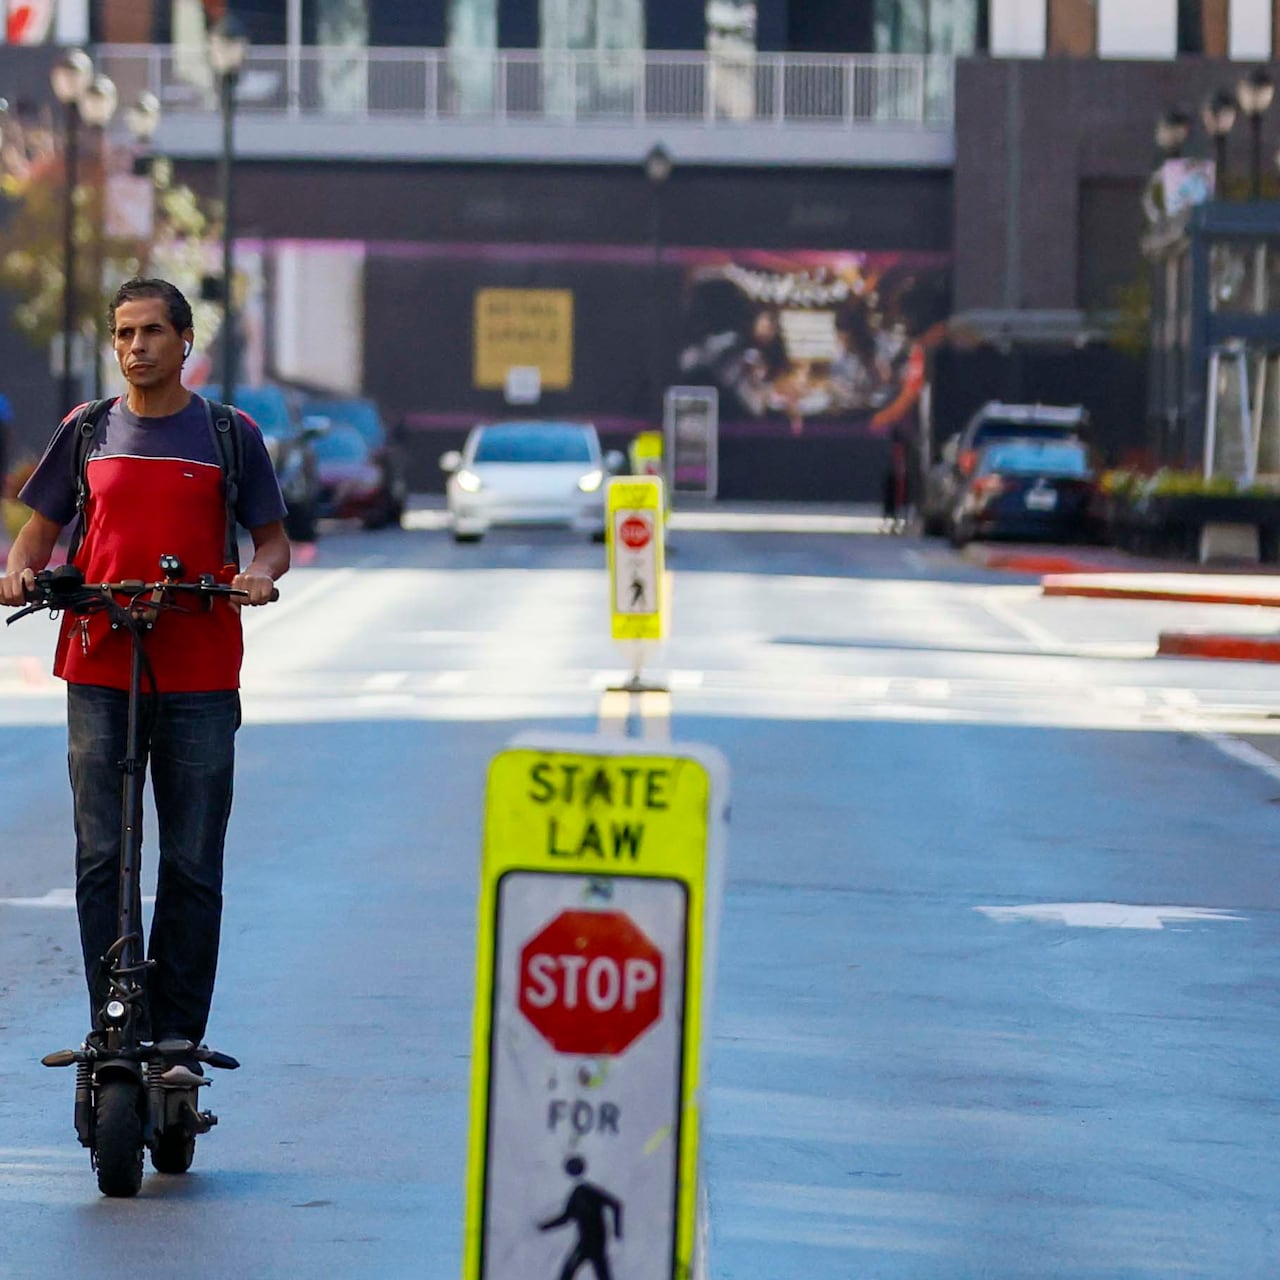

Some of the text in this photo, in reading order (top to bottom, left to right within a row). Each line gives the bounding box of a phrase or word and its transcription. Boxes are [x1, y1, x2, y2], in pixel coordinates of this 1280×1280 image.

[528, 763, 671, 811] STATE
[546, 816, 646, 860] LAW
[524, 953, 658, 1013] STOP
[546, 1098, 621, 1135] FOR
